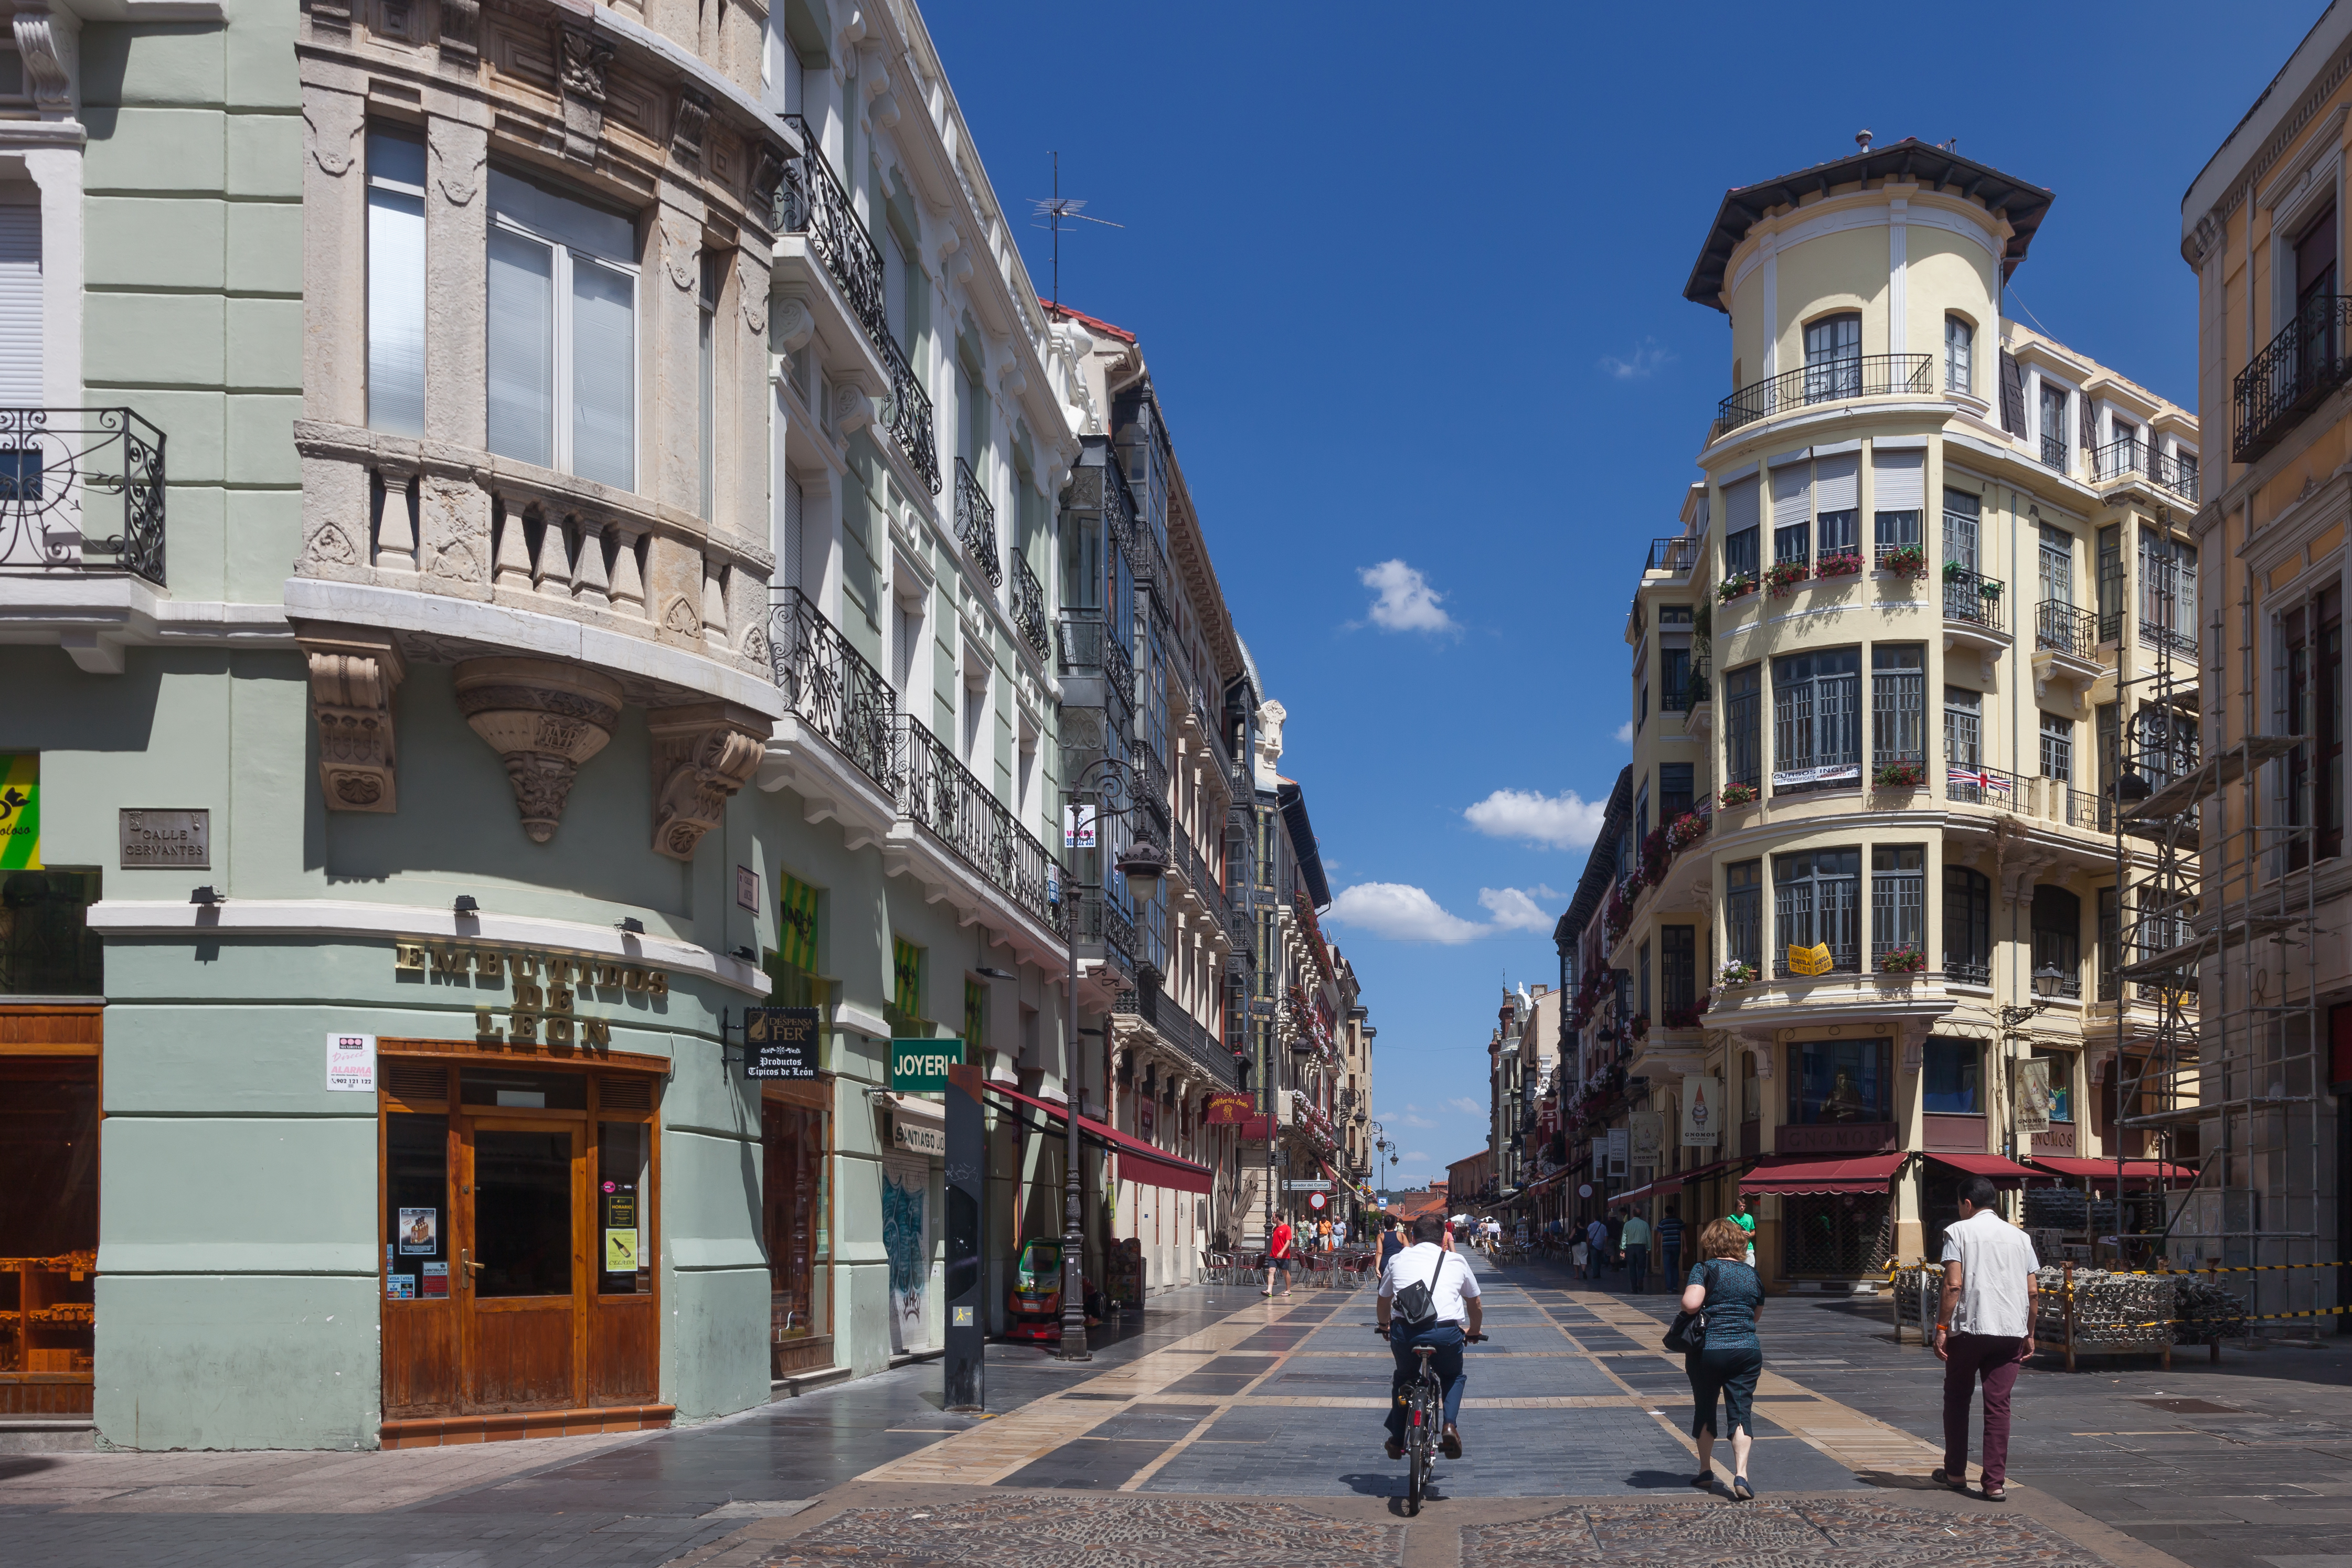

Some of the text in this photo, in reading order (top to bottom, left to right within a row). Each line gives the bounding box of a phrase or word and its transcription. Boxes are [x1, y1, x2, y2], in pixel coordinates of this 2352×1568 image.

[1774, 765, 1860, 779] CURSOS INGLÉS
[143, 829, 188, 840] CALLE
[126, 845, 203, 856] CERVANTES
[1791, 957, 1811, 966] ALQUILA
[395, 944, 669, 996] EMBUTIDOS
[512, 983, 574, 1014] DE
[475, 1011, 611, 1044] LEON
[773, 1026, 806, 1041] FER
[332, 1049, 369, 1062] Direct
[760, 1057, 802, 1066] Productos
[748, 1066, 813, 1076] Típicos de León
[895, 1126, 935, 1149] SANTIAGO
[1789, 1130, 1879, 1147] GNOMOS
